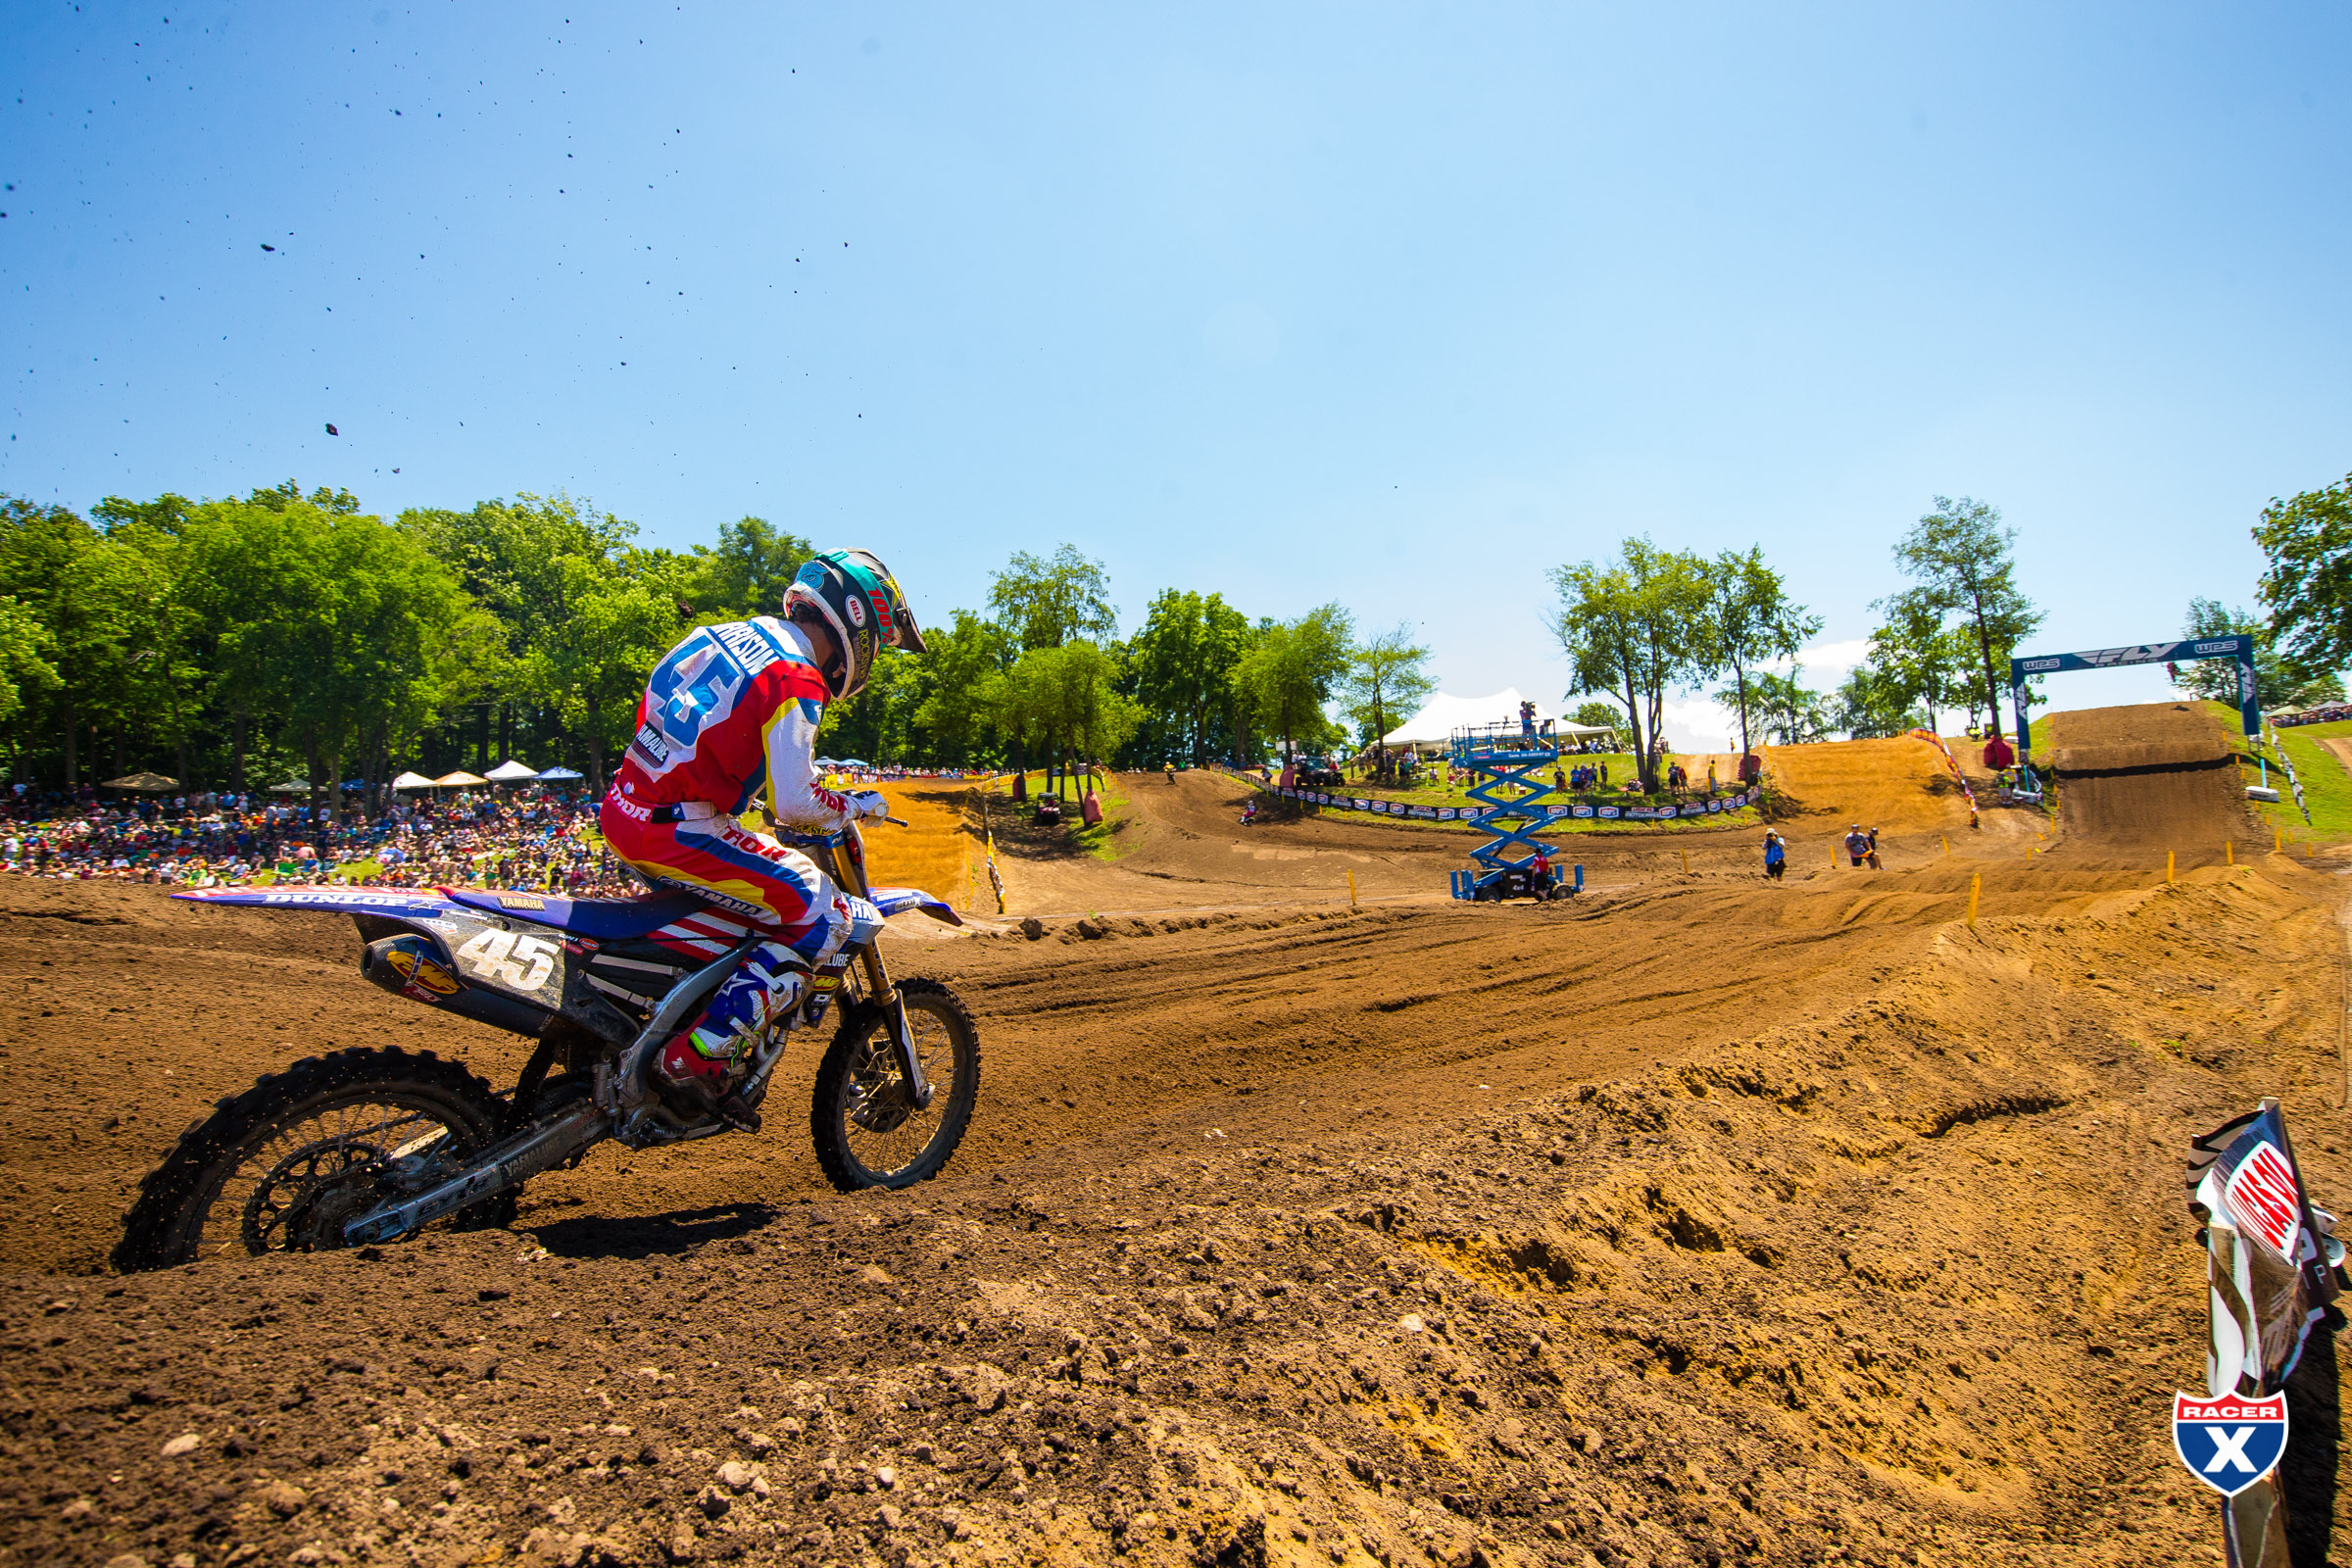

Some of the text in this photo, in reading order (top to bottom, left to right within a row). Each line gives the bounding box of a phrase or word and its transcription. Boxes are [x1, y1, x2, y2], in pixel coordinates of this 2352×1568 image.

[849, 600, 862, 623] BELL
[867, 587, 893, 644] 100%
[710, 622, 780, 675] RRISON
[2072, 642, 2180, 664] FLY
[2195, 640, 2239, 655] WPS
[2023, 659, 2060, 671] WPS
[651, 635, 740, 746] 45
[636, 724, 669, 762] AMALUBE
[610, 783, 652, 821] THOR
[266, 894, 409, 906] DUNLOP
[499, 897, 545, 910] YAMAHA
[685, 885, 759, 915] YAMAHA
[456, 928, 561, 991] 45
